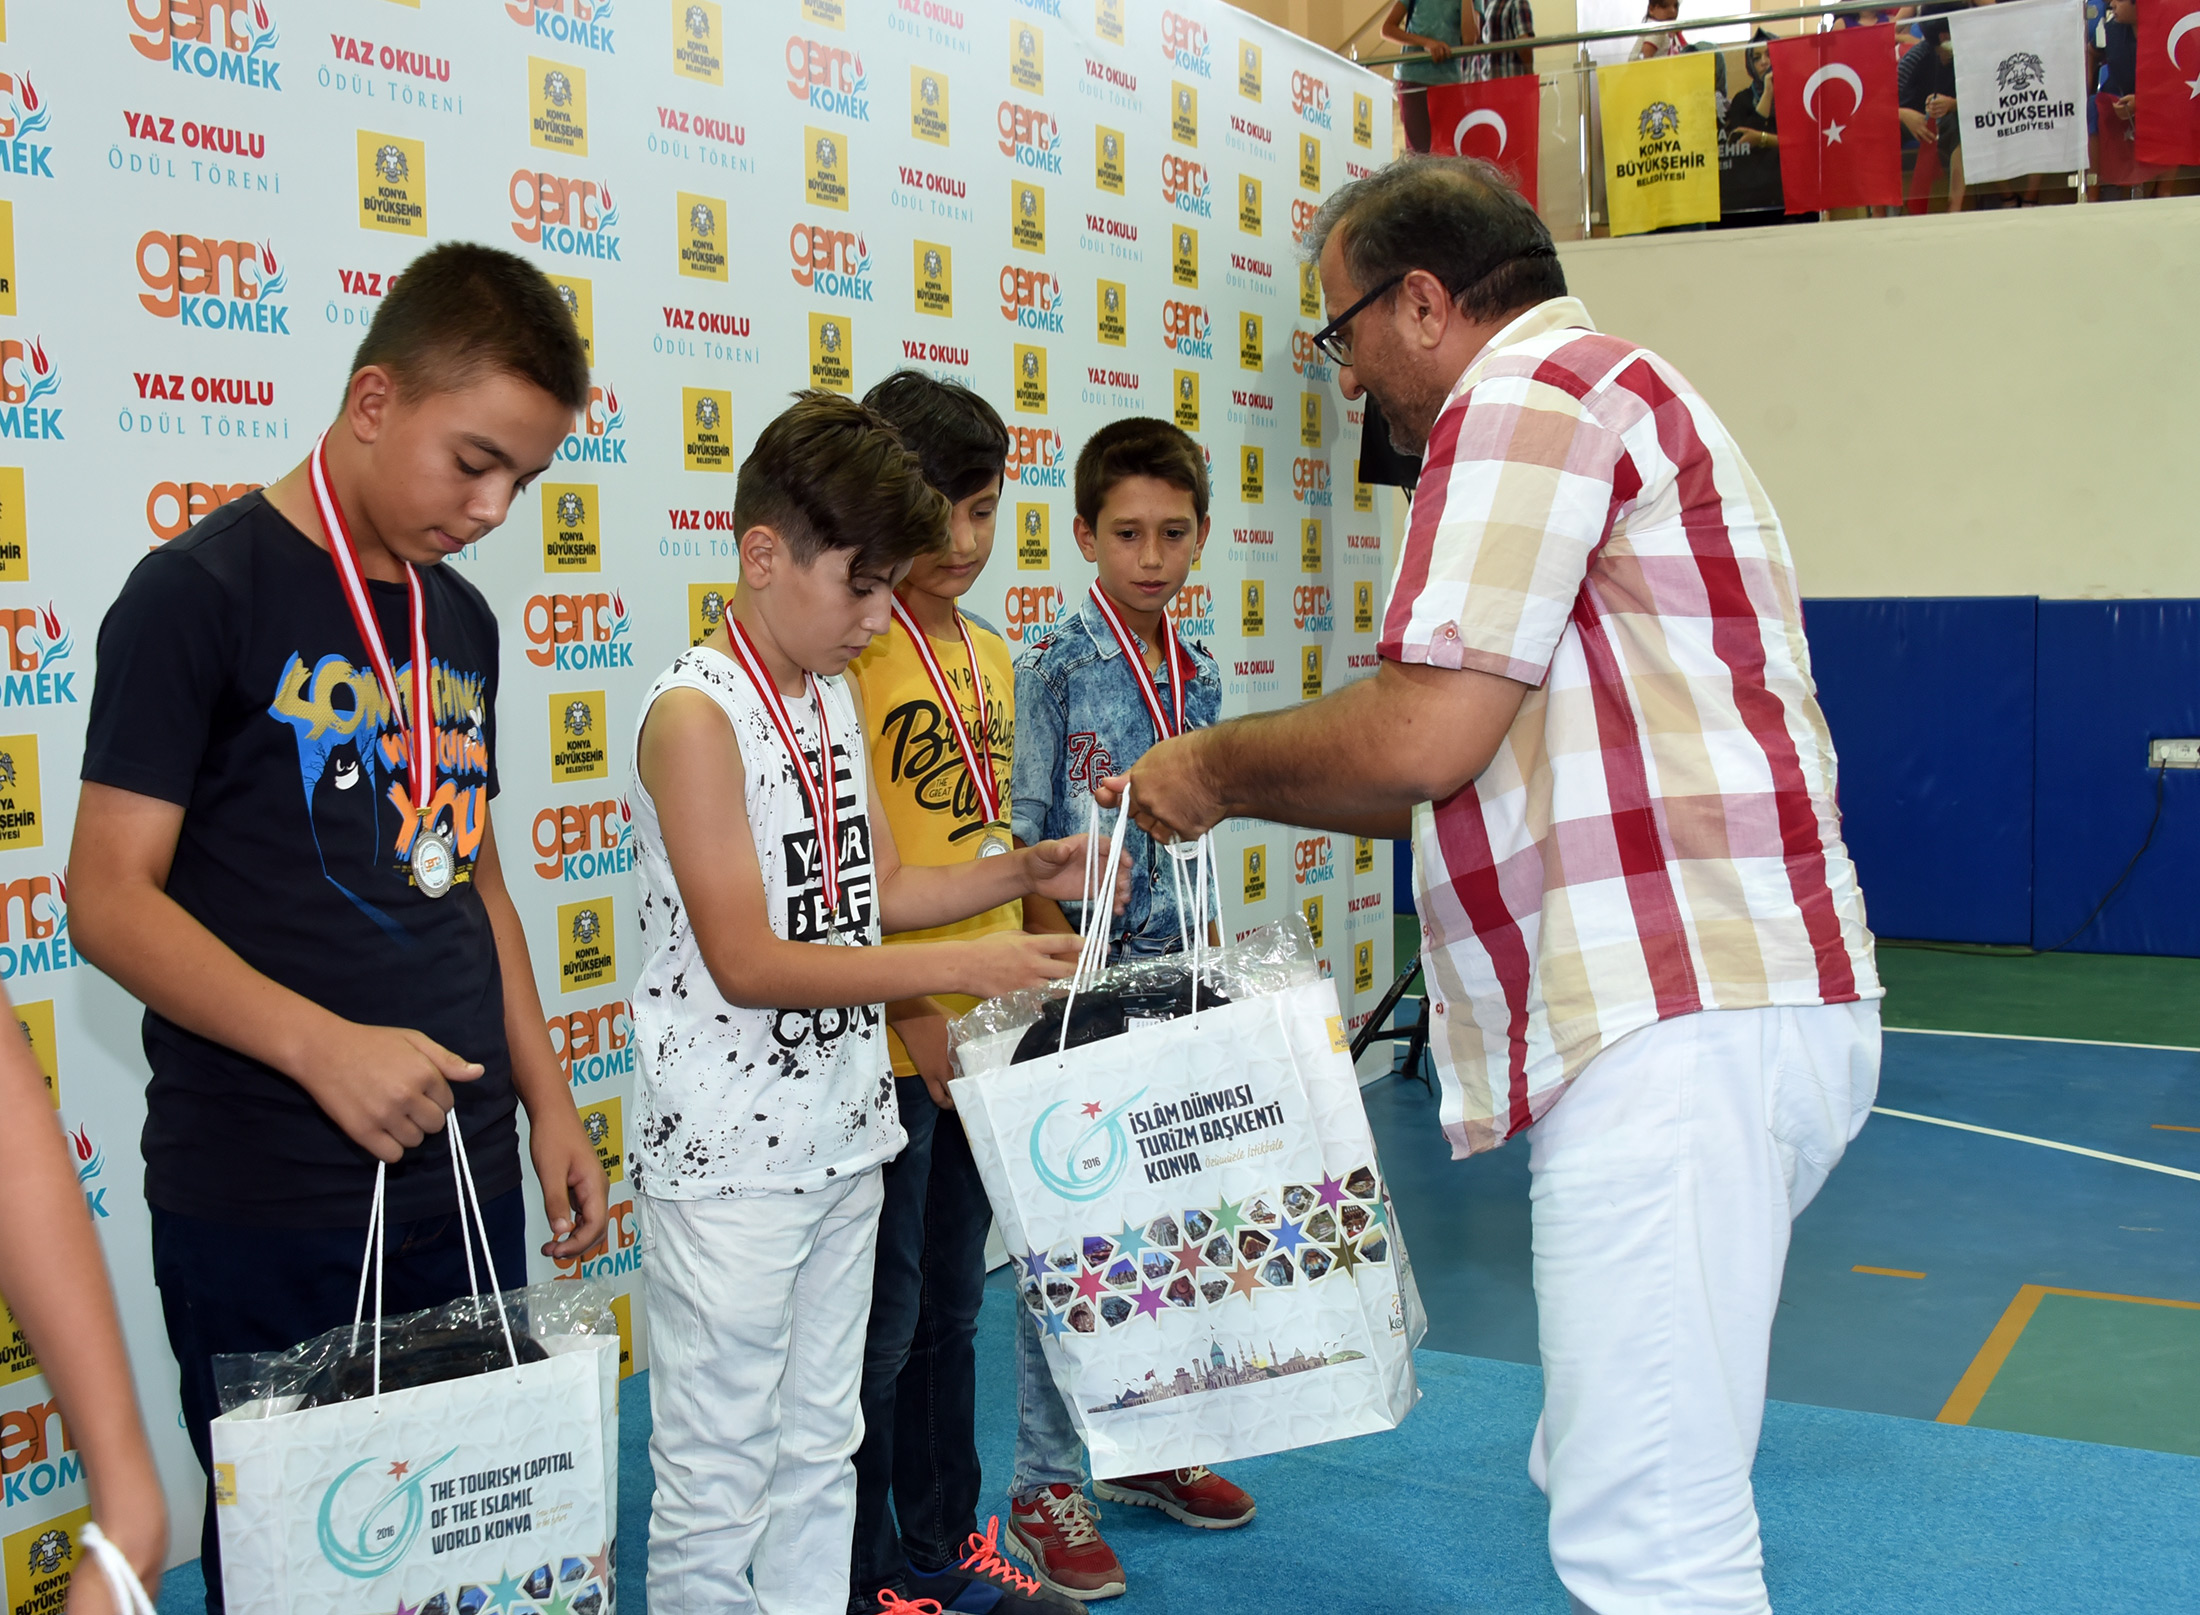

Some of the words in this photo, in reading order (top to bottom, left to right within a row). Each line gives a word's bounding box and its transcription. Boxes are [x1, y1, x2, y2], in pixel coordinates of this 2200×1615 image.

[535, 10, 615, 54] KOMEK
[172, 41, 282, 91] KOMEK
[330, 34, 374, 66] YAZ
[380, 46, 450, 82] OKULU
[785, 35, 852, 100] genç
[1175, 48, 1211, 79] KOMEK
[1085, 58, 1104, 79] YAZ
[1106, 68, 1137, 91] OKULU
[318, 65, 375, 97] ÖDÜL
[388, 82, 463, 115] TÖRENİ
[809, 85, 869, 122] KOMEK
[1999, 89, 2048, 108] KONYA
[534, 118, 583, 139] BÜYÜKŞEHİR
[546, 109, 571, 122] KONYA
[657, 106, 689, 133] YAZ
[693, 116, 745, 146] OKULU
[998, 100, 1048, 157] genç
[1230, 115, 1245, 133] YAZ
[1247, 122, 1272, 144] OKULU
[1975, 102, 2075, 129] BÜYÜKŞEHİR
[1997, 120, 2054, 138] BELEDİYESİ
[124, 110, 175, 144] YAZ
[182, 122, 265, 159] OKULU
[1015, 144, 1062, 175] KOMEK
[1639, 140, 1681, 158] KONYA
[108, 144, 176, 178] ÖDÜL
[192, 161, 280, 194] TÖRENİ
[1616, 153, 1705, 178] BÜYÜKŞEHİR
[1636, 171, 1685, 187] BELEDİYESİ
[378, 186, 407, 200] KONYA
[899, 166, 923, 188] YAZ
[926, 173, 966, 199] OKULU
[363, 197, 422, 218] BÜYÜKŞEHİR
[509, 169, 598, 243] genç
[1175, 191, 1211, 219] KOMEK
[1086, 214, 1104, 232] YAZ
[1107, 219, 1137, 241] OKULU
[541, 226, 621, 261] KOMEK
[682, 249, 724, 266] BÜYÜKŞEHİR
[692, 239, 714, 251] KONYA
[790, 223, 856, 286] genç
[136, 230, 258, 318] genç
[1231, 253, 1246, 271] YAZ
[1247, 259, 1272, 278] OKULU
[338, 269, 381, 297] YAZ
[814, 270, 873, 301] KOMEK
[1000, 265, 1050, 321] genç
[181, 296, 290, 335] KOMEK
[326, 300, 369, 326] ÖDÜ
[663, 307, 694, 330] YAZ
[698, 312, 750, 337] OKULU
[1018, 307, 1064, 333] KOMEK
[653, 333, 695, 357] ÖDÜL
[705, 342, 760, 364] TÖRENİ
[902, 340, 926, 360] YAZ
[929, 344, 968, 366] OKULU
[1176, 335, 1213, 360] KOMEK
[133, 372, 185, 401] YAZ
[191, 377, 274, 406] OKULU
[1088, 367, 1106, 385] YAZ
[1108, 370, 1139, 390] OKULU
[1232, 390, 1247, 407] YAZ
[1249, 393, 1273, 410] OKULU
[0, 407, 65, 440] MEK
[119, 407, 186, 435] ÖDÜL
[201, 415, 289, 439] TÖRENİ
[687, 443, 730, 457] BÜYÜKŞEHİR
[698, 433, 719, 443] KONYA
[1020, 465, 1066, 488] KOMEK
[668, 509, 700, 530] YAZ
[547, 541, 596, 556] BÜYÜKŞEHİR
[559, 532, 584, 541] KONYA
[660, 537, 700, 556] ÖDÜL
[1233, 528, 1247, 544] YAZ
[1249, 530, 1273, 545] OKULU
[1005, 586, 1056, 641] genç
[523, 593, 610, 667] genç
[556, 643, 634, 671] KOMEK
[1234, 661, 1249, 676] YAZ
[1250, 660, 1274, 675] OKULU
[555, 750, 604, 767] BÜYÜKŞEHİR
[566, 740, 591, 751] KONYA
[532, 800, 618, 880] genç
[563, 955, 612, 976] BÜYÜKŞEHİR
[575, 946, 599, 959] KONYA
[573, 1048, 634, 1087] KOME
[1128, 1102, 1180, 1135] İSLÂM
[1180, 1084, 1254, 1121] DÜNYASI
[1136, 1125, 1199, 1159] TURİZM
[1199, 1101, 1284, 1143] BAŞKENTİ
[1082, 1156, 1101, 1170] 2016
[1144, 1152, 1202, 1184] KONYA
[430, 1480, 456, 1503] THE
[459, 1464, 522, 1498] TOURISM
[523, 1451, 574, 1480] CAPITAL
[432, 1508, 451, 1529] OF
[452, 1501, 478, 1524] THE
[480, 1487, 533, 1516] ISLAMIC
[376, 1525, 395, 1541] 2016
[432, 1525, 481, 1554] WORLD
[485, 1514, 532, 1543] KONYA
